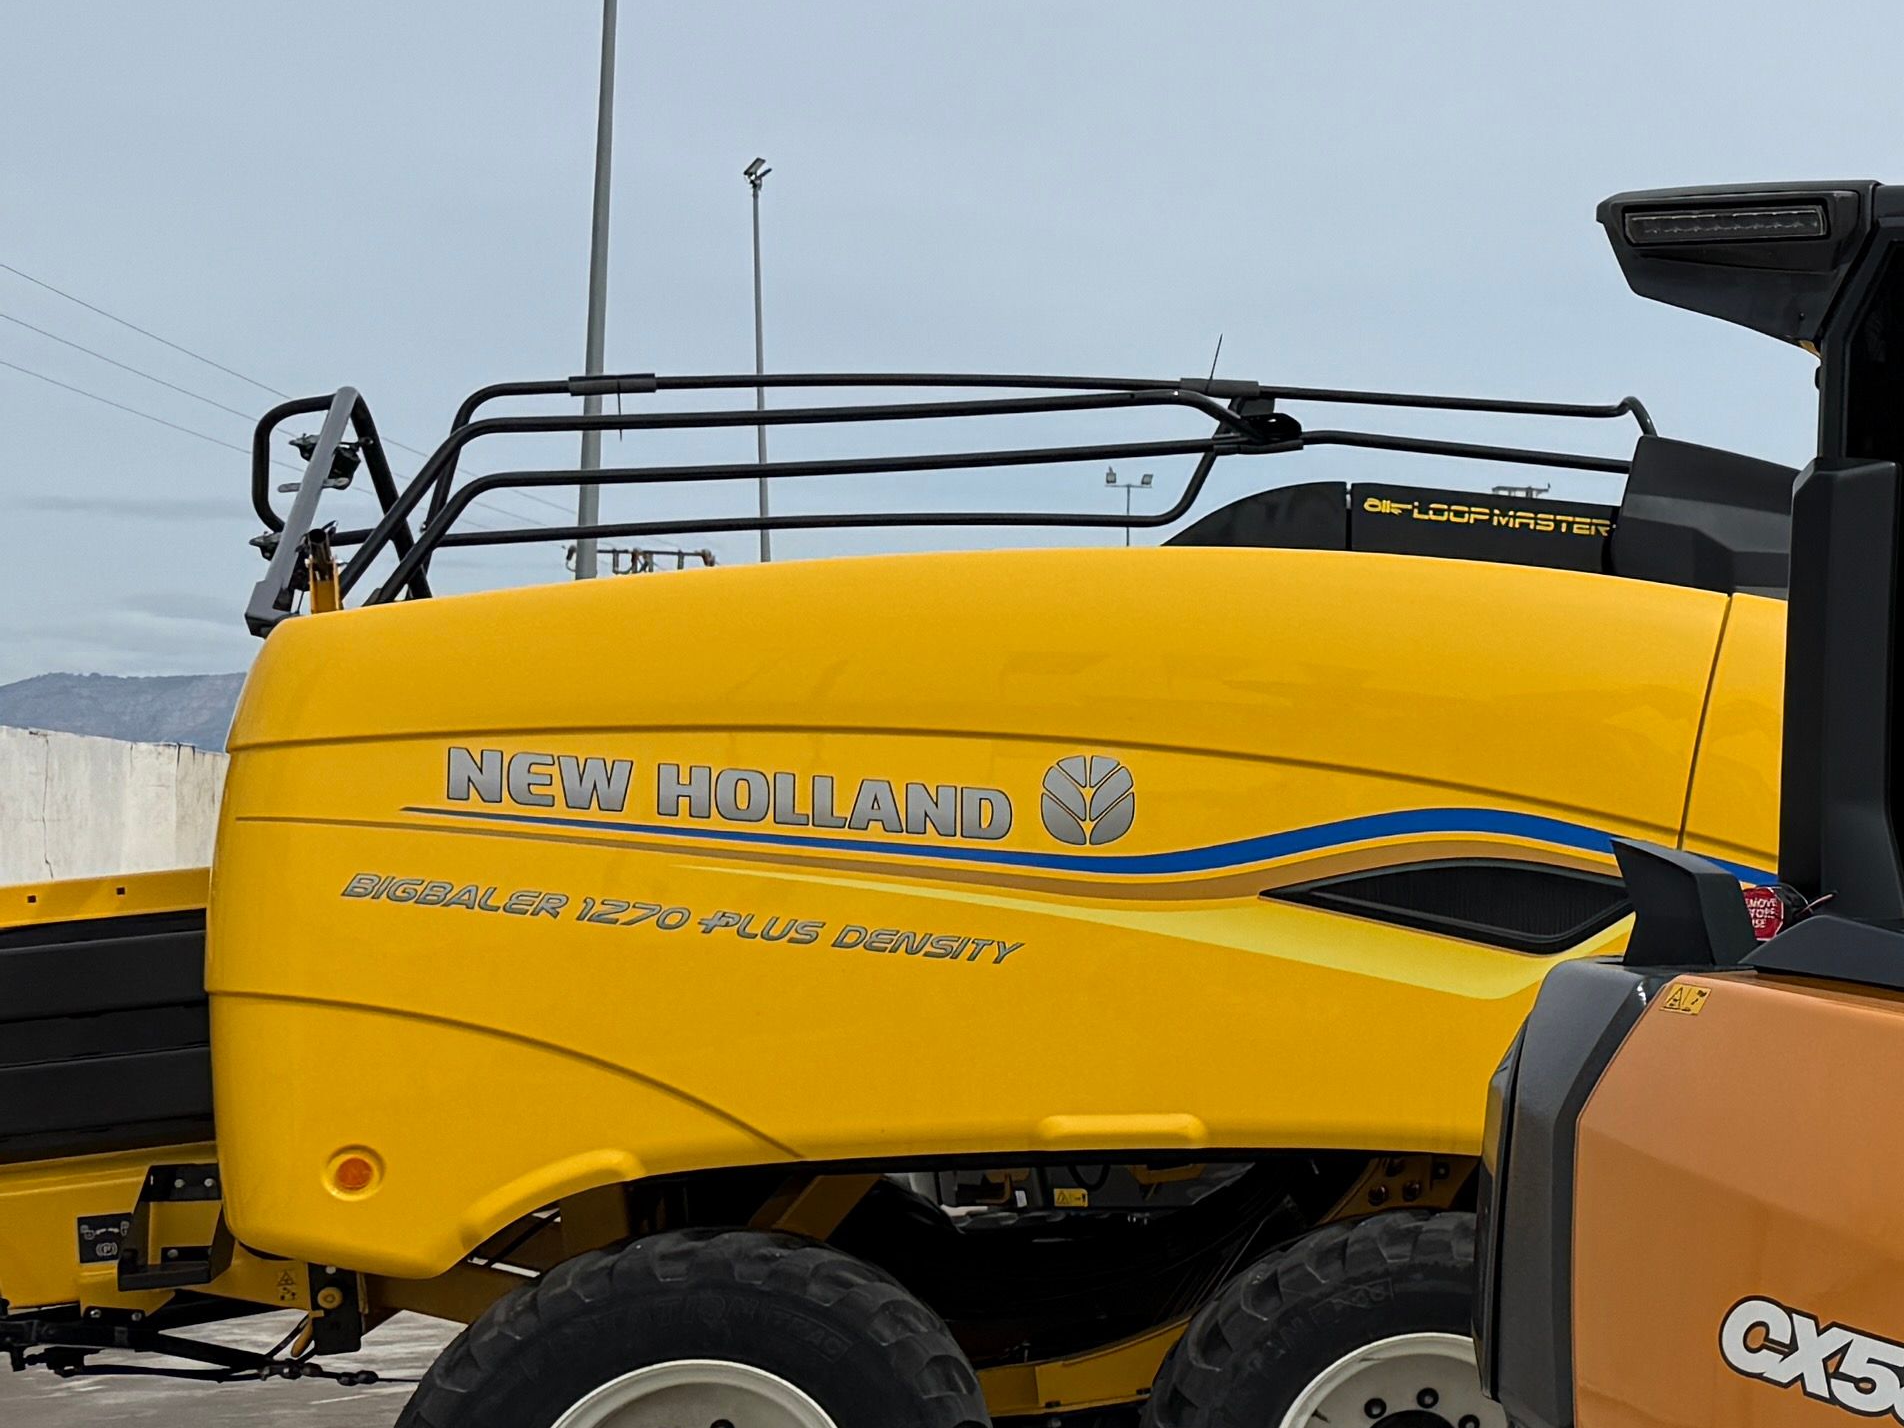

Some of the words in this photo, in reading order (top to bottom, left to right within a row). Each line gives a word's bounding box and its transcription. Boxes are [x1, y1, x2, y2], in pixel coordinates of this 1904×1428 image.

[447, 746, 633, 812] NEW
[657, 762, 1013, 840] HOLLAND
[341, 872, 569, 920] BIGBALER
[576, 898, 691, 930] 1270
[831, 924, 1026, 965] DENSITY
